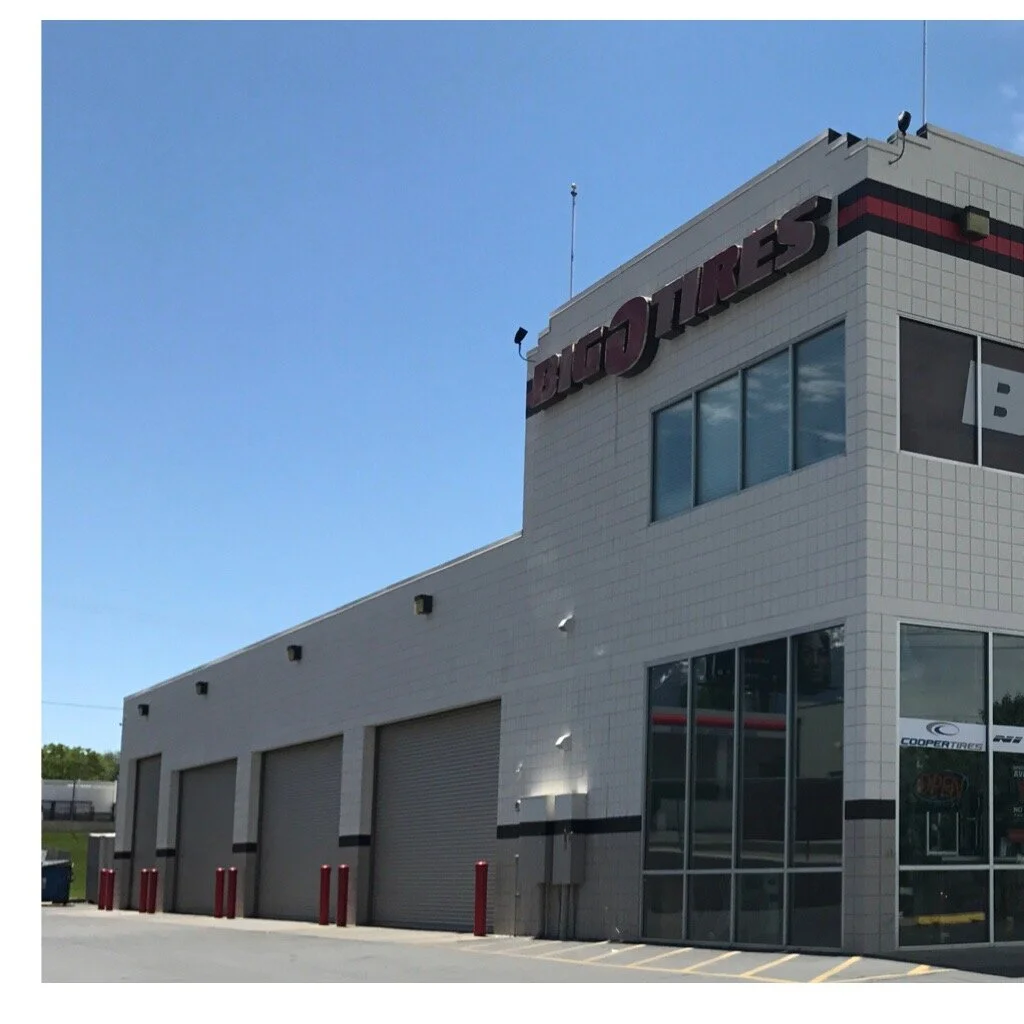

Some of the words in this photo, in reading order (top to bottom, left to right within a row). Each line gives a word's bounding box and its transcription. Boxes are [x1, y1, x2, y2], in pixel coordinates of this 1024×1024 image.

[527, 325, 609, 412] BIG
[603, 295, 660, 379] O
[651, 195, 832, 340] TIRES
